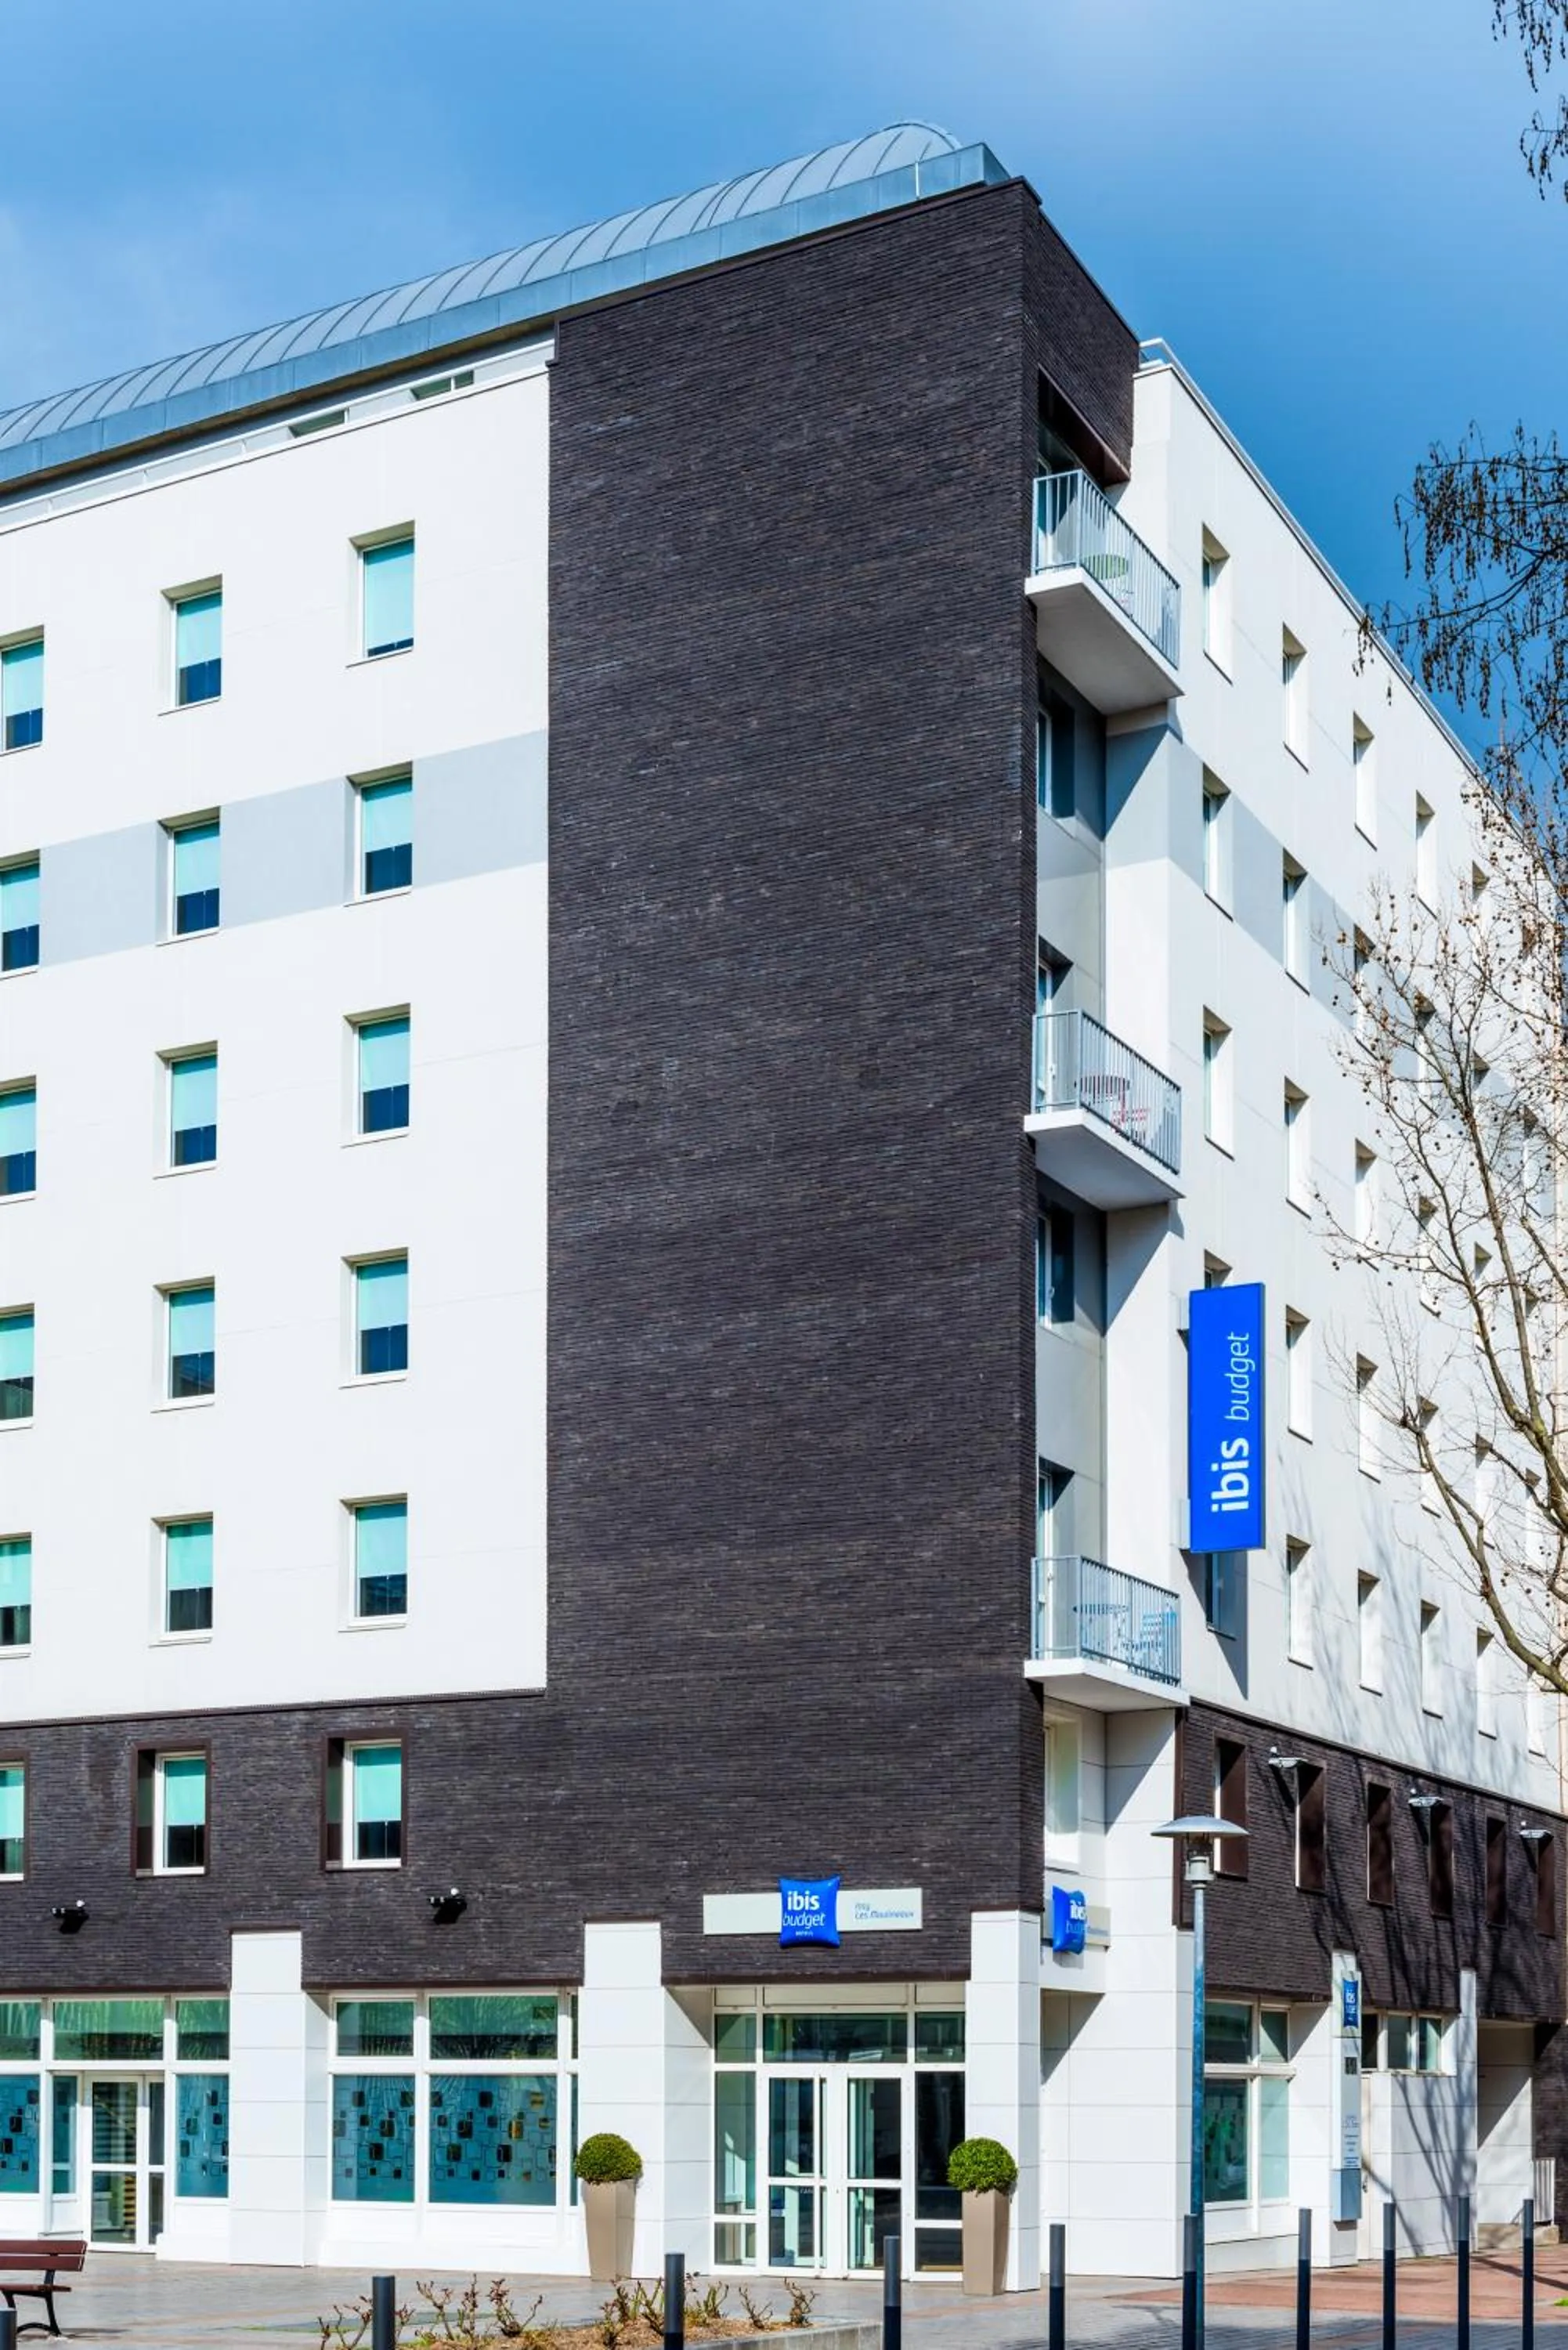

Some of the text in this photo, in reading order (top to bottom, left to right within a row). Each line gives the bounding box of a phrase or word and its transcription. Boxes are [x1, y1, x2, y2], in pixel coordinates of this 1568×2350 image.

[1211, 1331, 1255, 1513] ibis budget
[787, 1889, 820, 1911] ibis
[782, 1911, 826, 1929] budget
